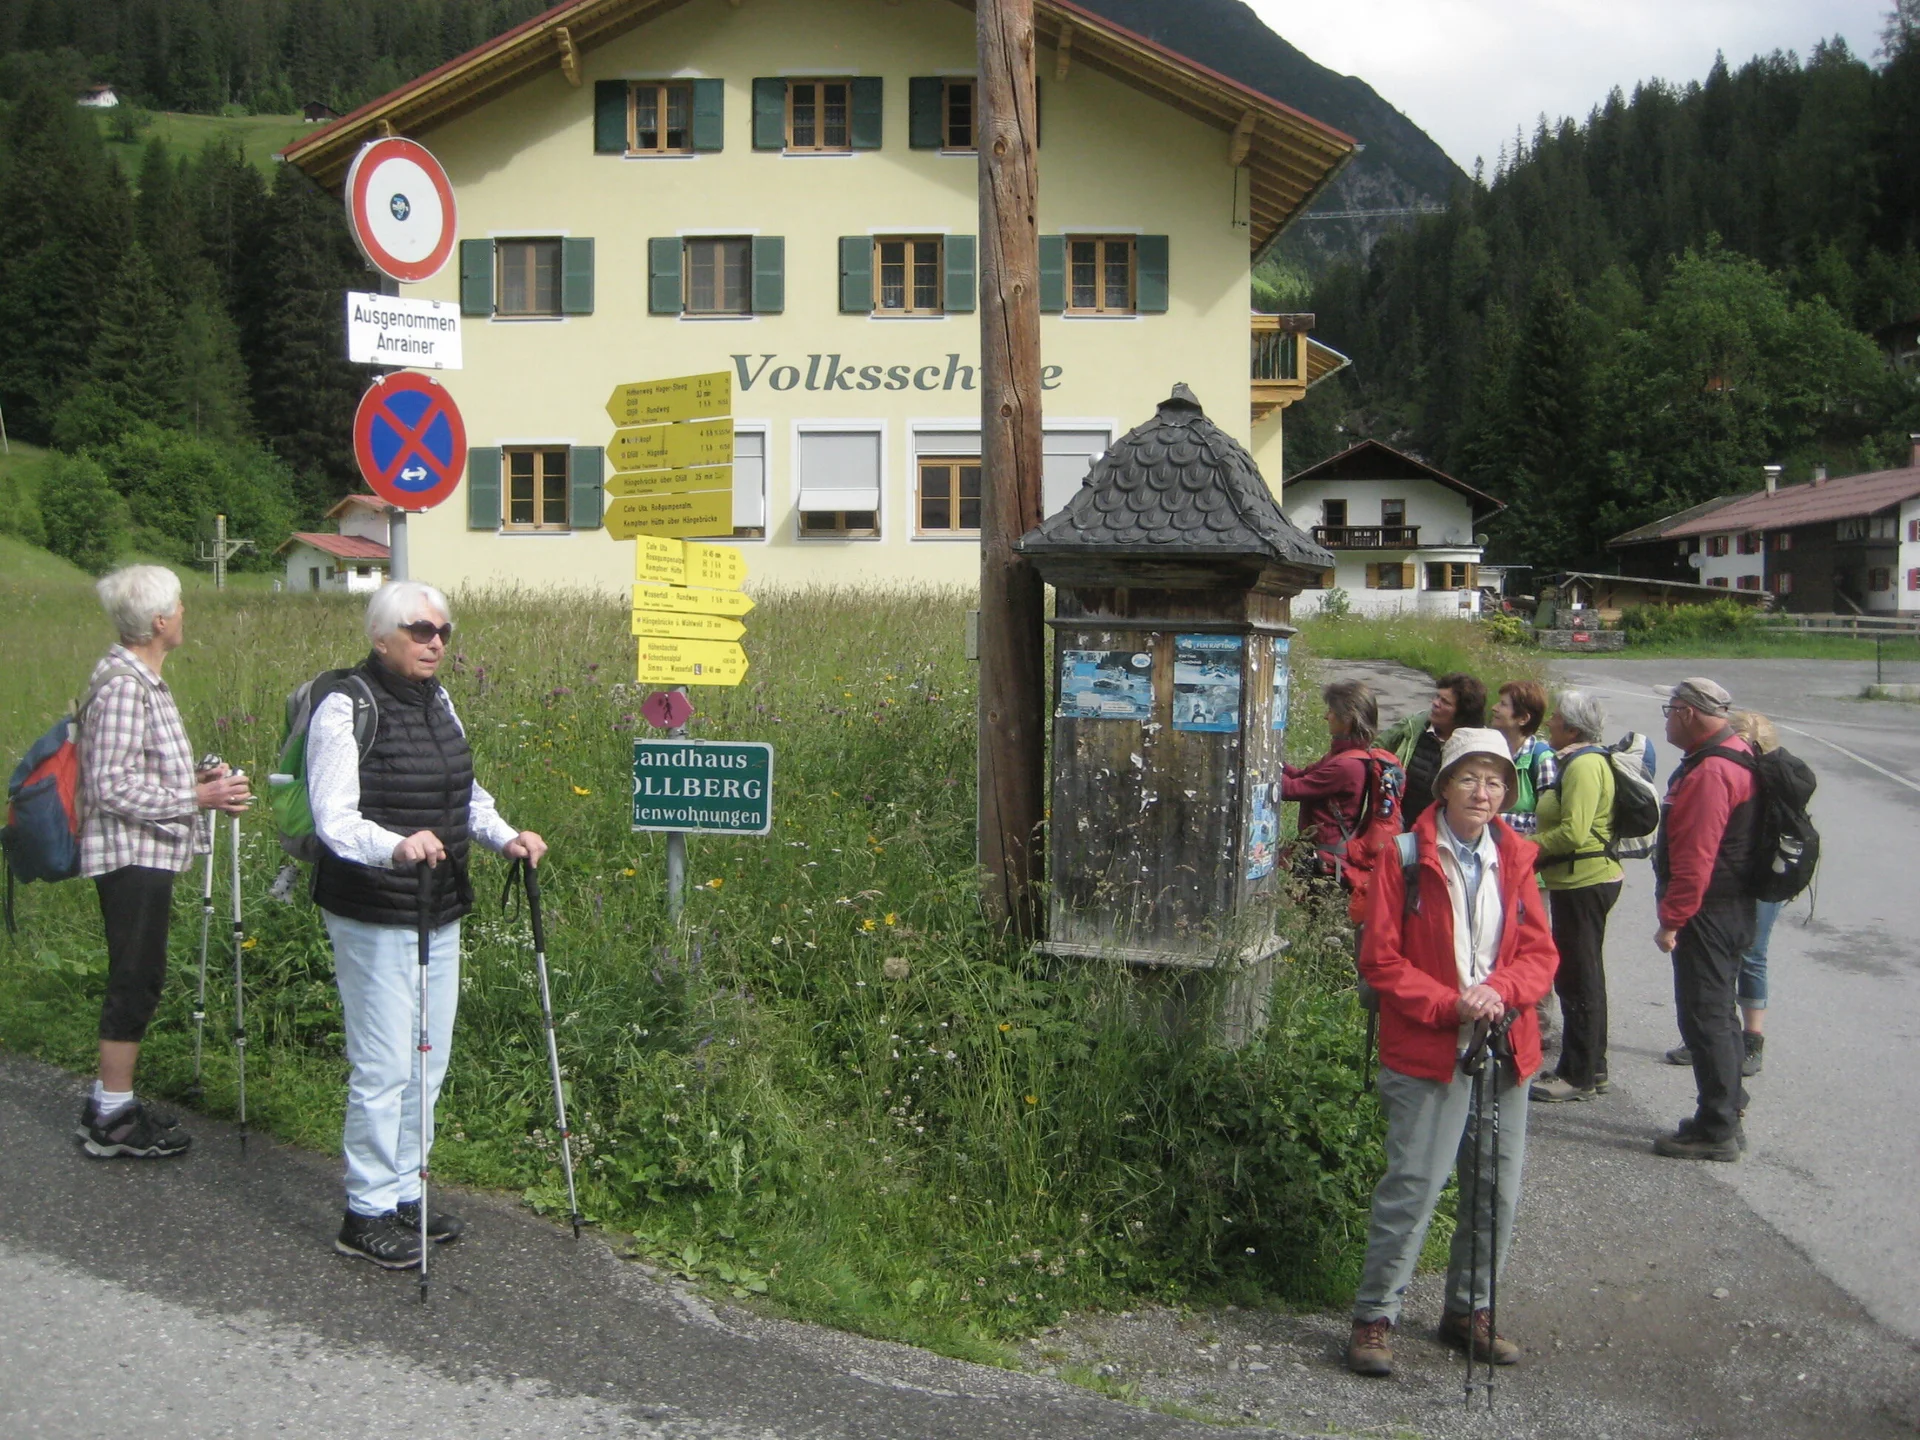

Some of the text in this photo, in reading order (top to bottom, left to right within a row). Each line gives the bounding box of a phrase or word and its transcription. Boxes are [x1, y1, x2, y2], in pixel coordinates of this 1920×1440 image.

[354, 304, 456, 332] Ausgenommen
[376, 332, 435, 355] Anrainer
[730, 354, 1063, 391] Volkssche
[683, 515, 718, 525] Hängebrücke
[646, 564, 668, 574] Kemptner
[644, 590, 668, 599] Wasserfall
[676, 592, 698, 602] Rundweg
[642, 617, 673, 627] Hängebrücke
[671, 664, 693, 673] Wasserfall
